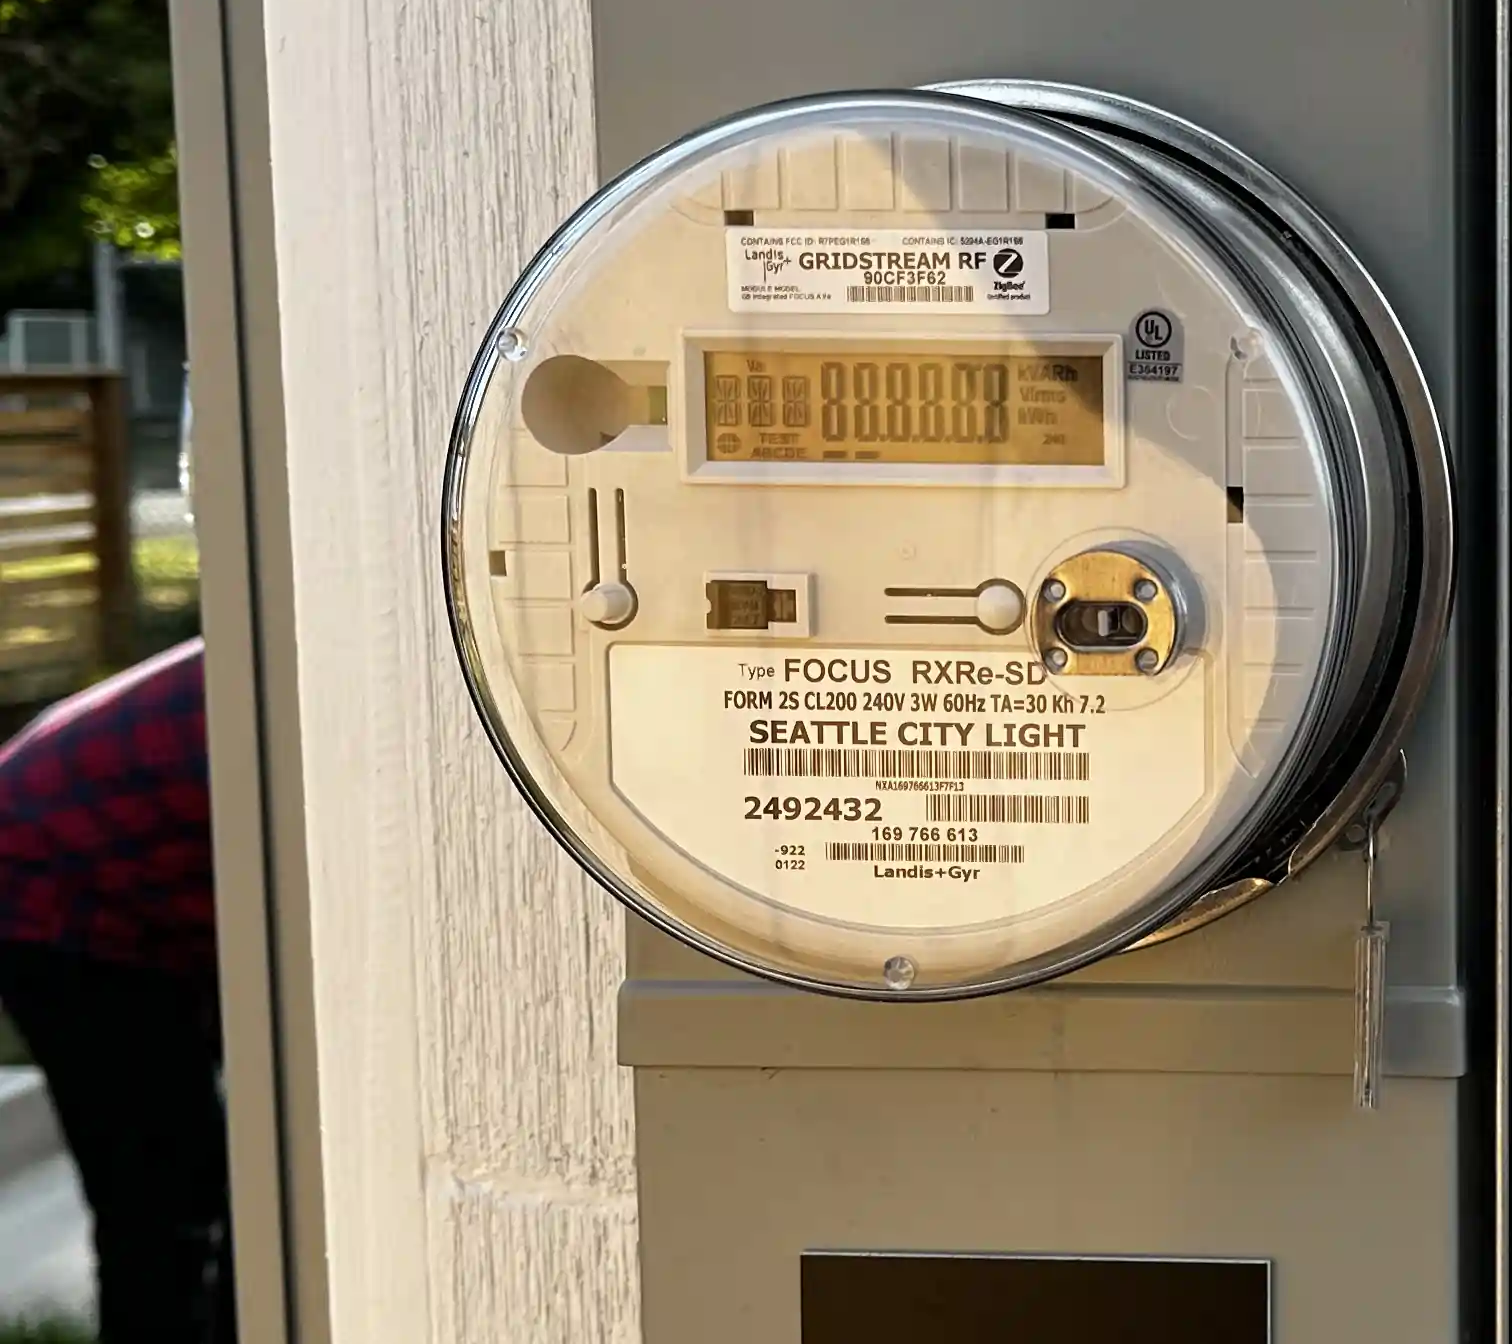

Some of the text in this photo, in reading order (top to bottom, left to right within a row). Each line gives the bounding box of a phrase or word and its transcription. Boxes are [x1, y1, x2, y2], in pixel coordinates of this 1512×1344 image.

[786, 236, 801, 246] FCC
[799, 252, 986, 270] GRIDSTREAM RF
[864, 271, 946, 285] 90CF3F62
[1135, 349, 1170, 361] LISTED
[738, 658, 1047, 685] Type FOCUS RXRe-SD
[724, 690, 1106, 714] FORM 2S CL200 240V 3W 60Hz TA=30 Kh 7.2
[750, 719, 1086, 748] SEATTLE CITY LIGHT
[744, 796, 882, 822] 2492432
[871, 826, 978, 843] 169 766 613
[774, 844, 806, 856] -922
[775, 859, 806, 871] 0122
[874, 864, 981, 883] Landis+Gyr
